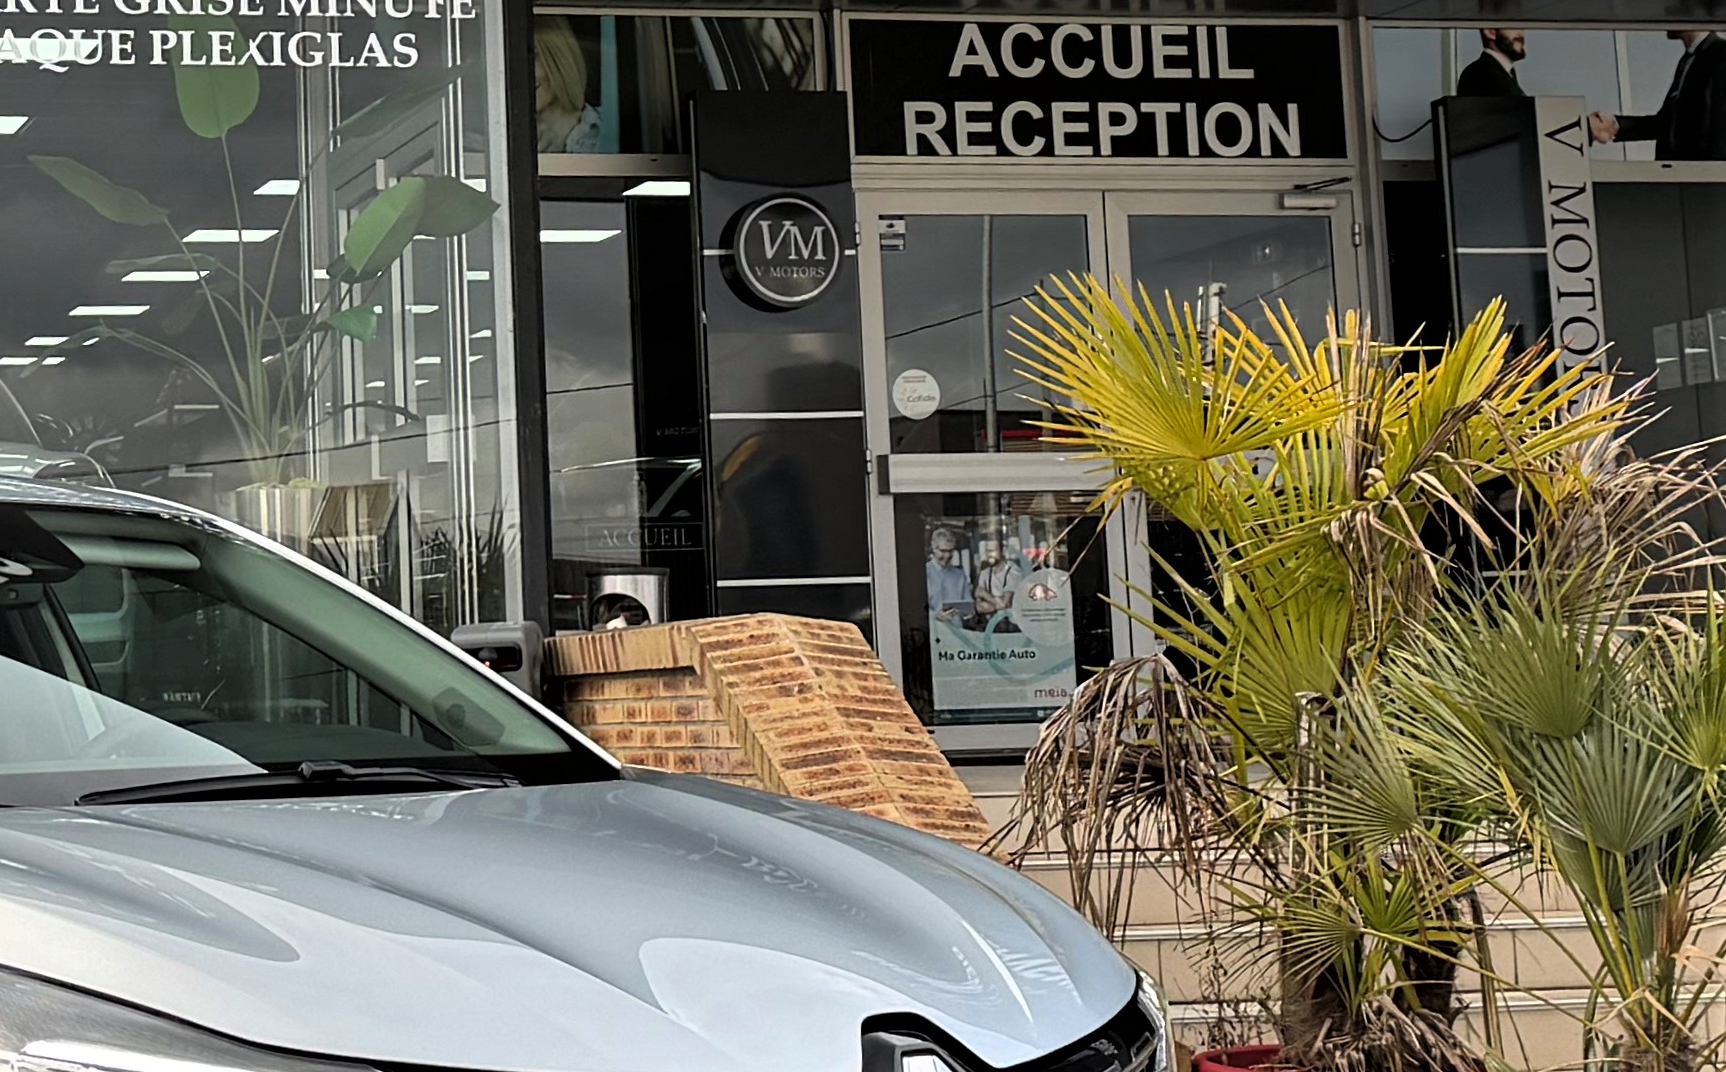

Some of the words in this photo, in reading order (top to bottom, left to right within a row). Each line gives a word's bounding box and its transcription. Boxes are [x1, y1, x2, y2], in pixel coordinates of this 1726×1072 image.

[149, 30, 419, 68] PLEXIGLAS
[948, 23, 1254, 80] ACCUEIL
[903, 100, 1302, 157] RECEPTION
[1544, 115, 1585, 157] V
[758, 220, 827, 261] VM
[754, 266, 765, 278] V
[770, 265, 825, 278] MOTORS
[1547, 180, 1606, 417] MOTOR
[598, 527, 692, 547] ACCUEIL
[938, 650, 955, 661] Ma
[957, 648, 1007, 661] Garantie
[1009, 649, 1036, 660] Auto
